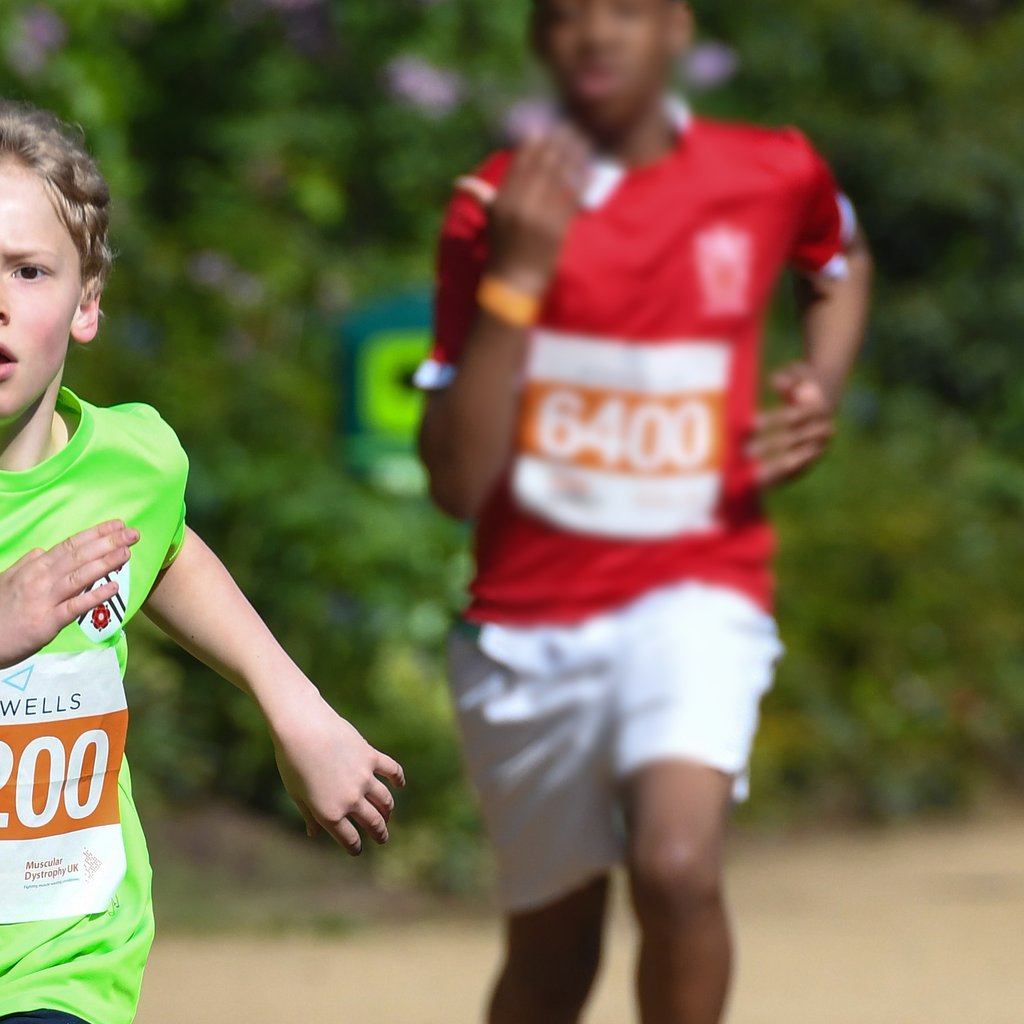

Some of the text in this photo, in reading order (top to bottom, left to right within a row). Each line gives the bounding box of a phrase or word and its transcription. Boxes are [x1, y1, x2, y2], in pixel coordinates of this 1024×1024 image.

[539, 391, 711, 470] 6400
[24, 867, 67, 882] Dystrophy
[67, 863, 79, 873] UK
[25, 857, 63, 870] Muscular
